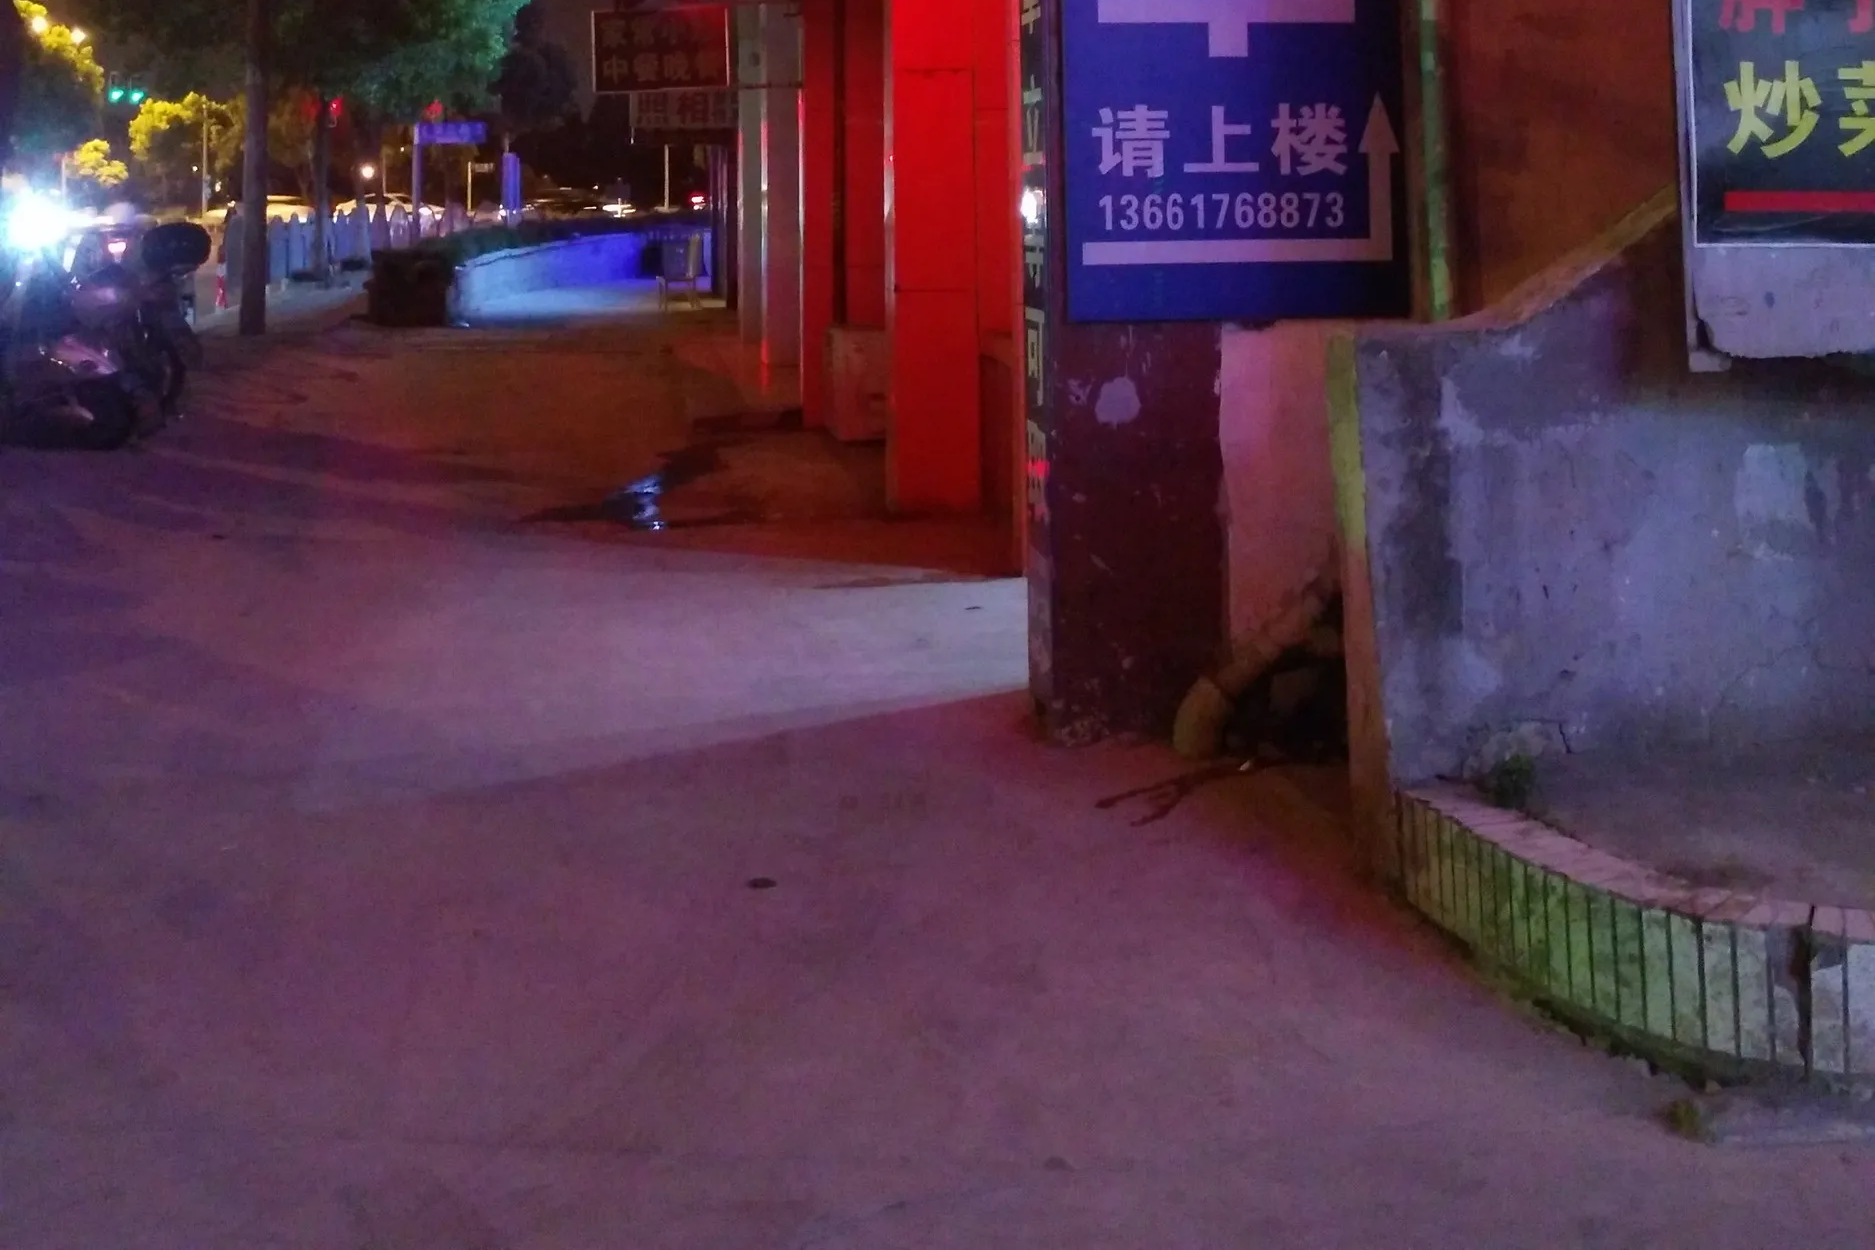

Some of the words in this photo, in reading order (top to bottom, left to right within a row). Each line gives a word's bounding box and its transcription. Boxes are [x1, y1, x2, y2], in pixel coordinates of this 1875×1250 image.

[1091, 102, 1349, 178] 请上楼
[1098, 192, 1345, 232] 13661768873
